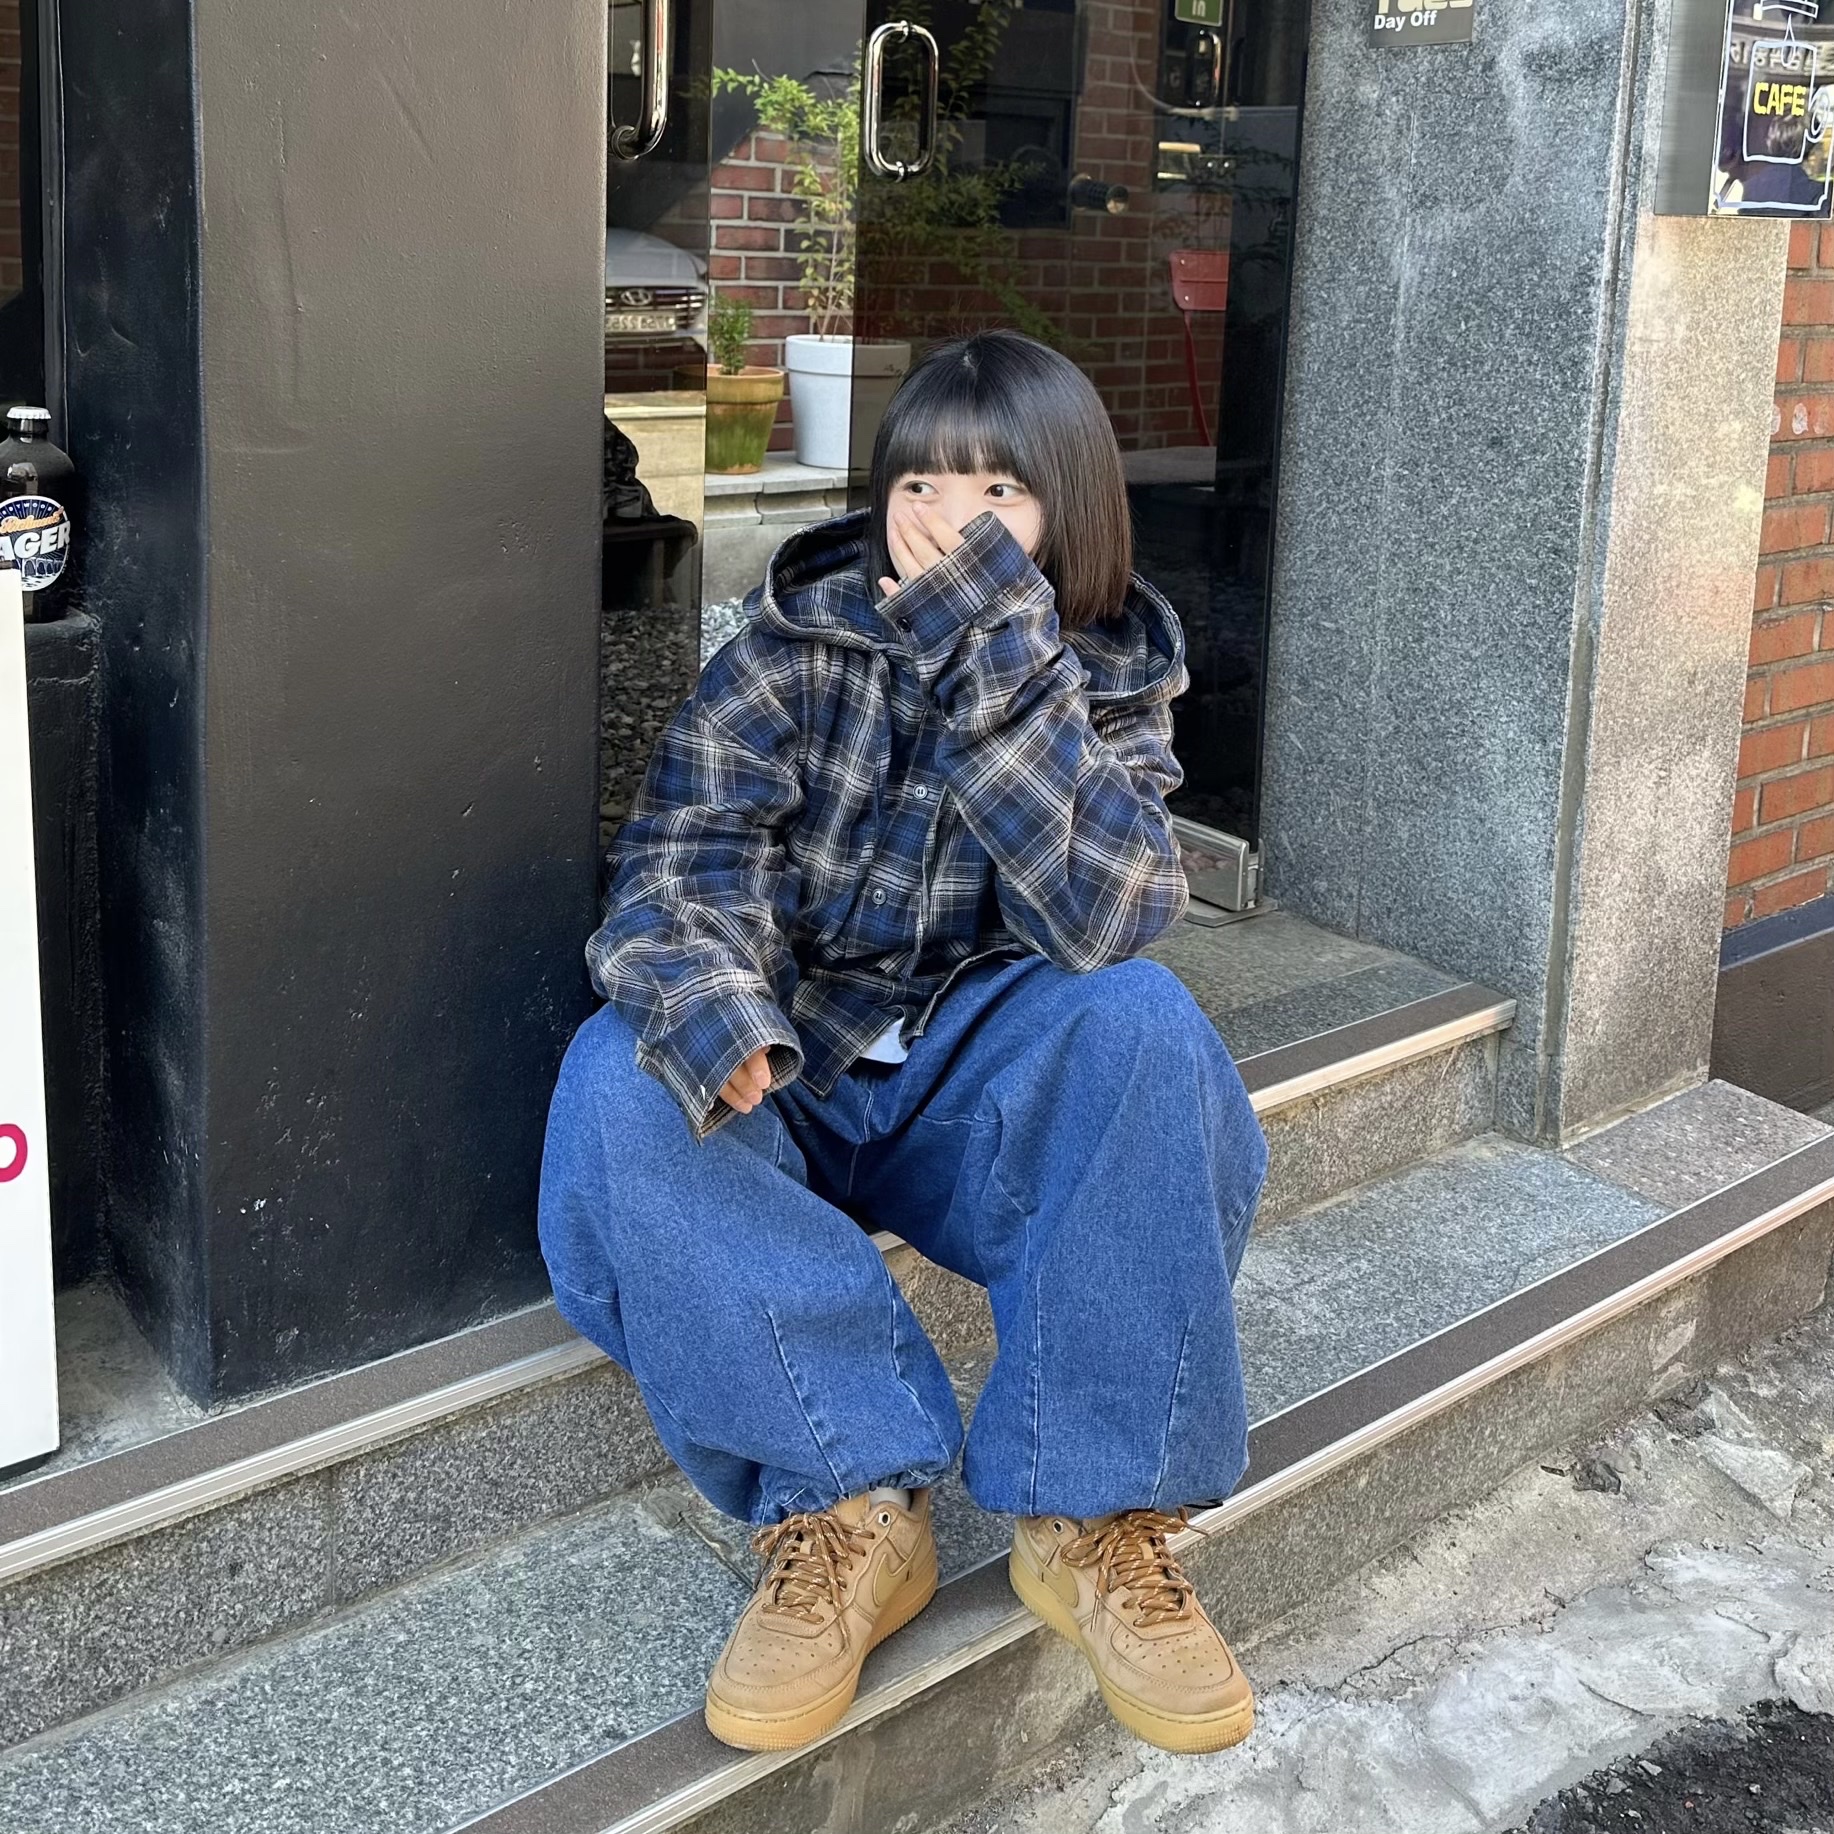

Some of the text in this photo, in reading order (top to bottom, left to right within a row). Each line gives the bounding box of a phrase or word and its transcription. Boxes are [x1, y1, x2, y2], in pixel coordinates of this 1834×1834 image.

[1373, 10, 1438, 32] Day Off
[1753, 82, 1807, 117] CAFE
